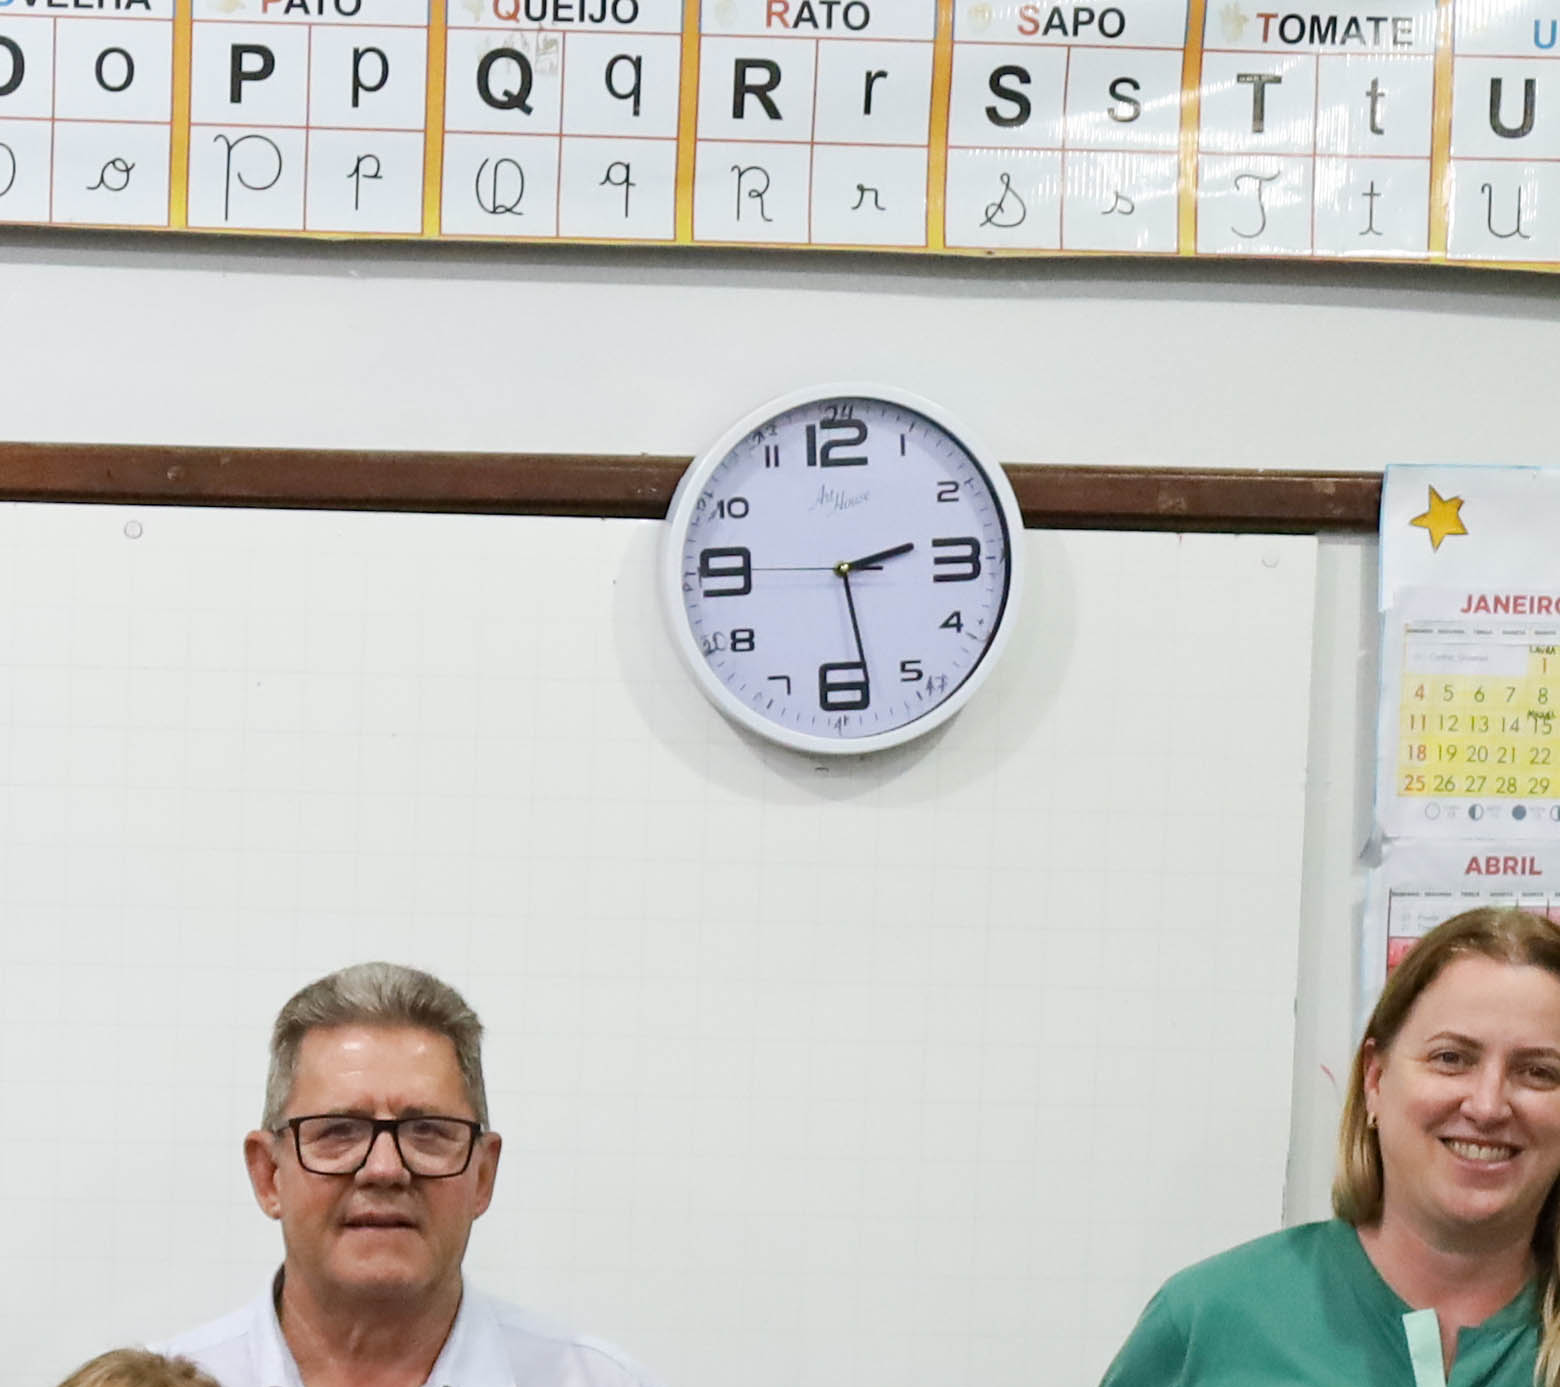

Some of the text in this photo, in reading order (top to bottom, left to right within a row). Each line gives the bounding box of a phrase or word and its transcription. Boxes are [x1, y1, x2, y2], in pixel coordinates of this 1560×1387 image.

[492, 0, 640, 28] QUEIJO
[765, 0, 870, 32] RATO
[1018, 4, 1127, 40] SAPO
[1258, 11, 1415, 48] TOMATE
[732, 57, 784, 119] R
[985, 64, 1034, 129] S
[806, 419, 868, 468] 12
[717, 497, 749, 519] 10
[937, 480, 959, 502] 2
[699, 546, 752, 597] 9
[932, 537, 980, 583] 3
[939, 611, 964, 633] 4
[730, 629, 755, 652] 8
[819, 661, 870, 711] 6
[900, 660, 923, 681] 5
[1464, 856, 1543, 878] ABRIL
